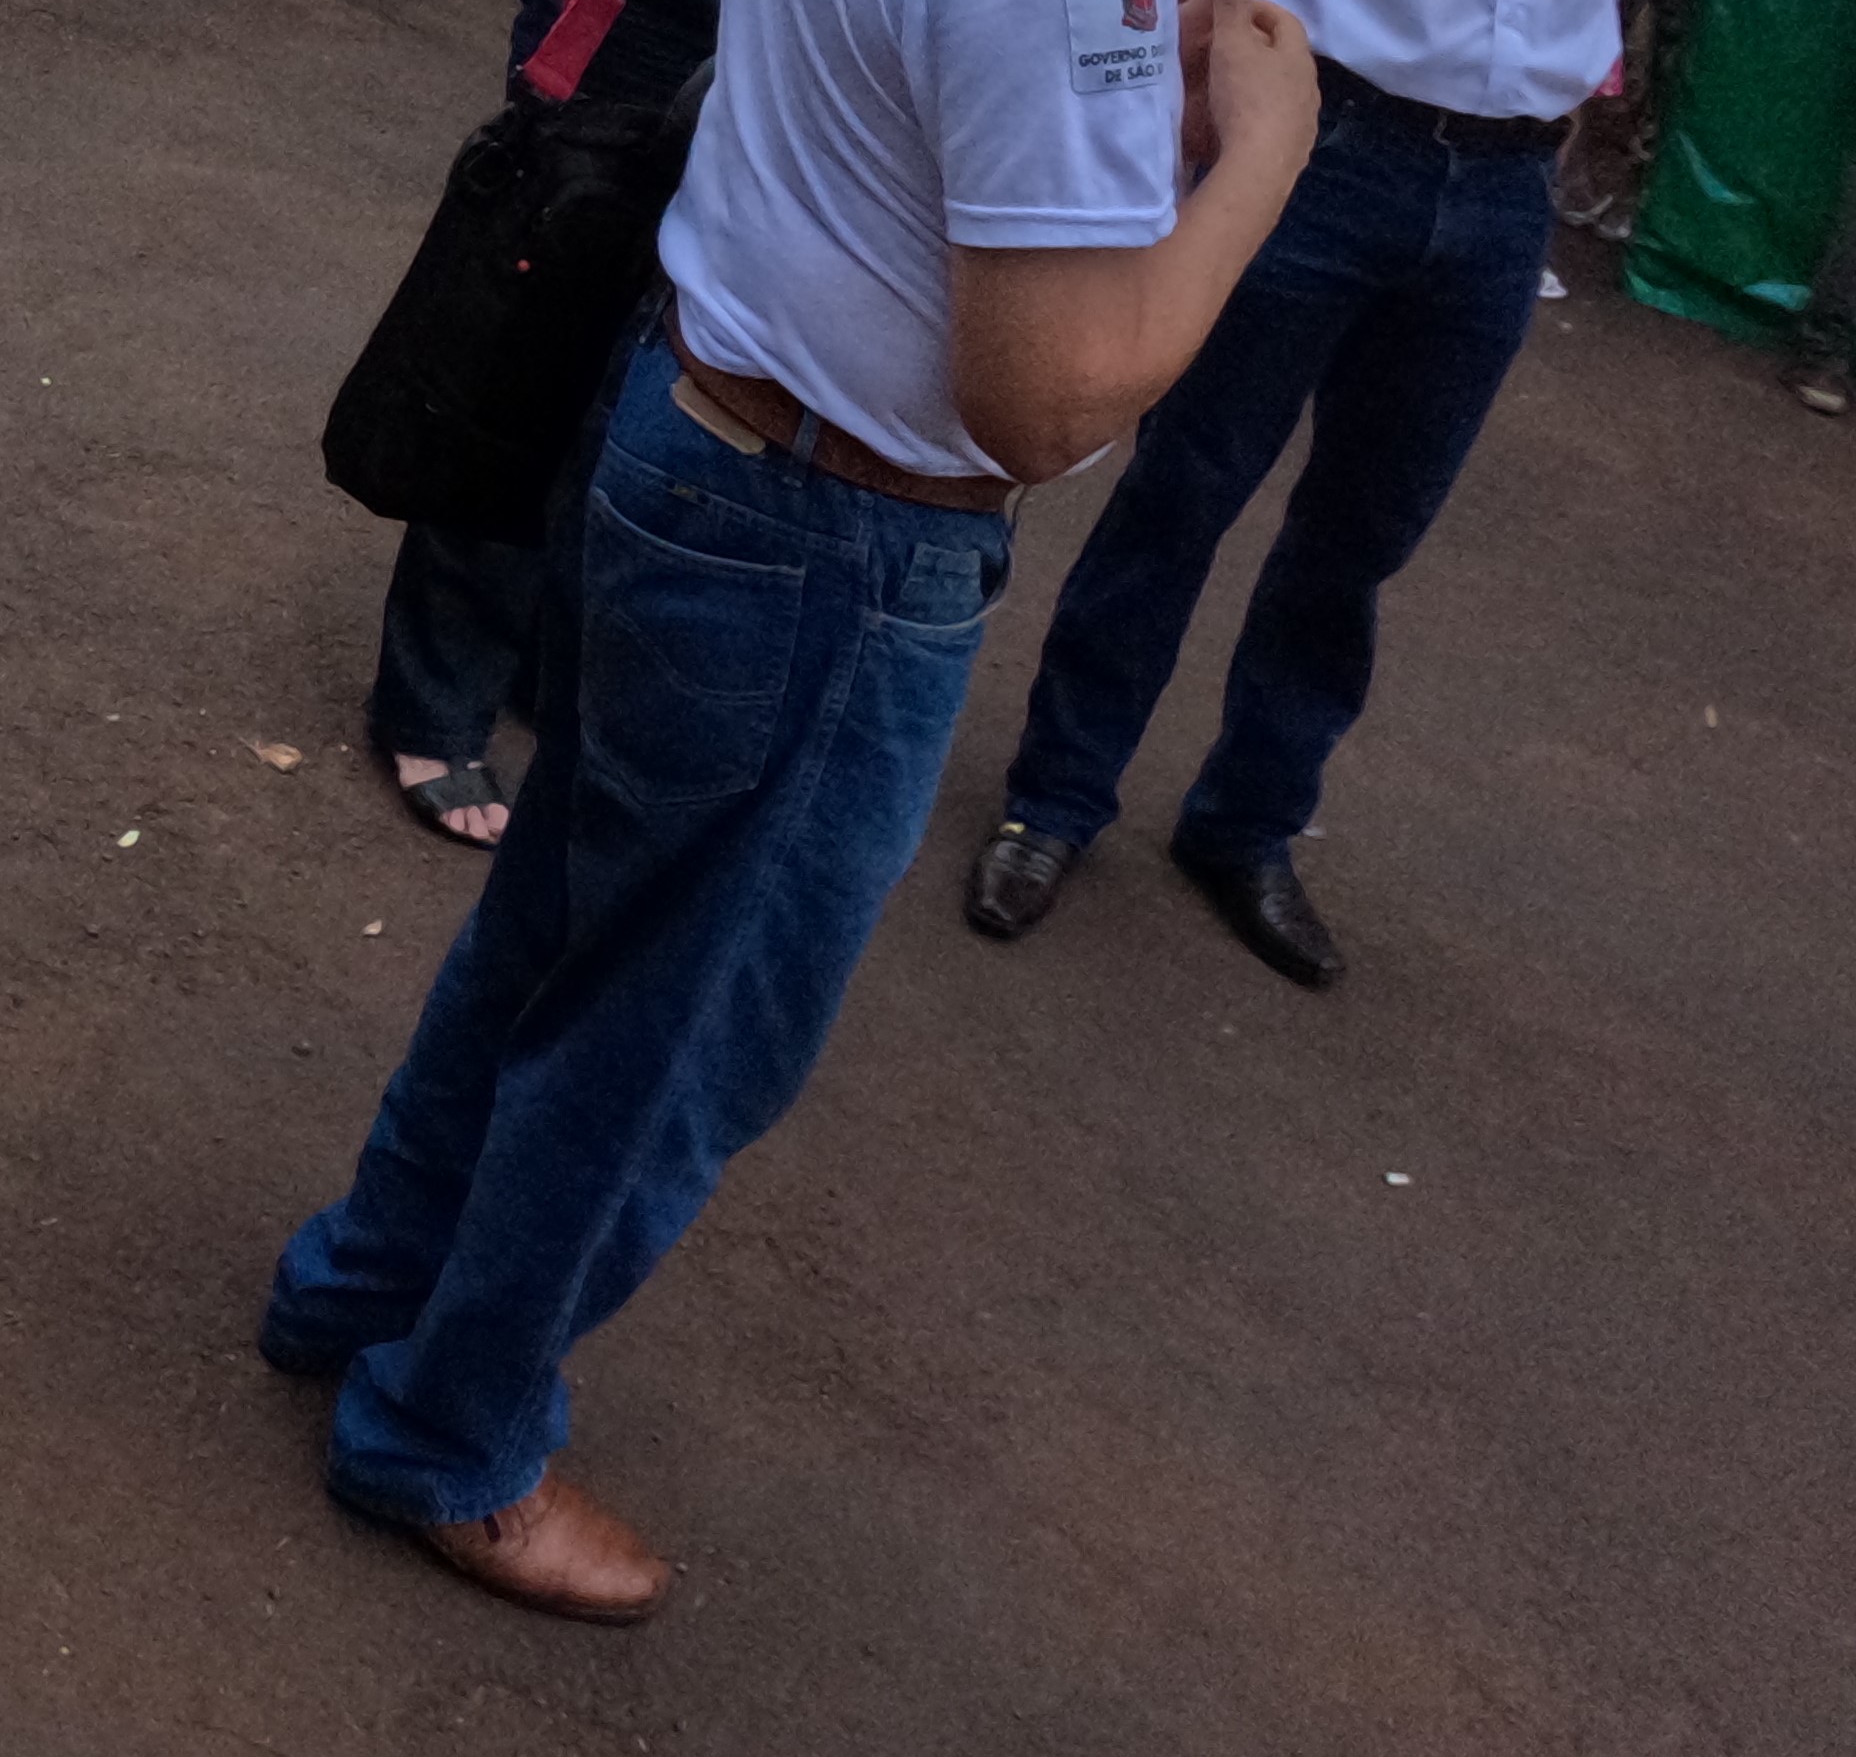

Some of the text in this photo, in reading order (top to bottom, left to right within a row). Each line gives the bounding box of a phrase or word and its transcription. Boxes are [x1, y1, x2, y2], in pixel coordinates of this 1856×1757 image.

[1078, 46, 1147, 68] GOVERNO
[1104, 68, 1122, 84] DE
[1127, 61, 1155, 80] SÃO
